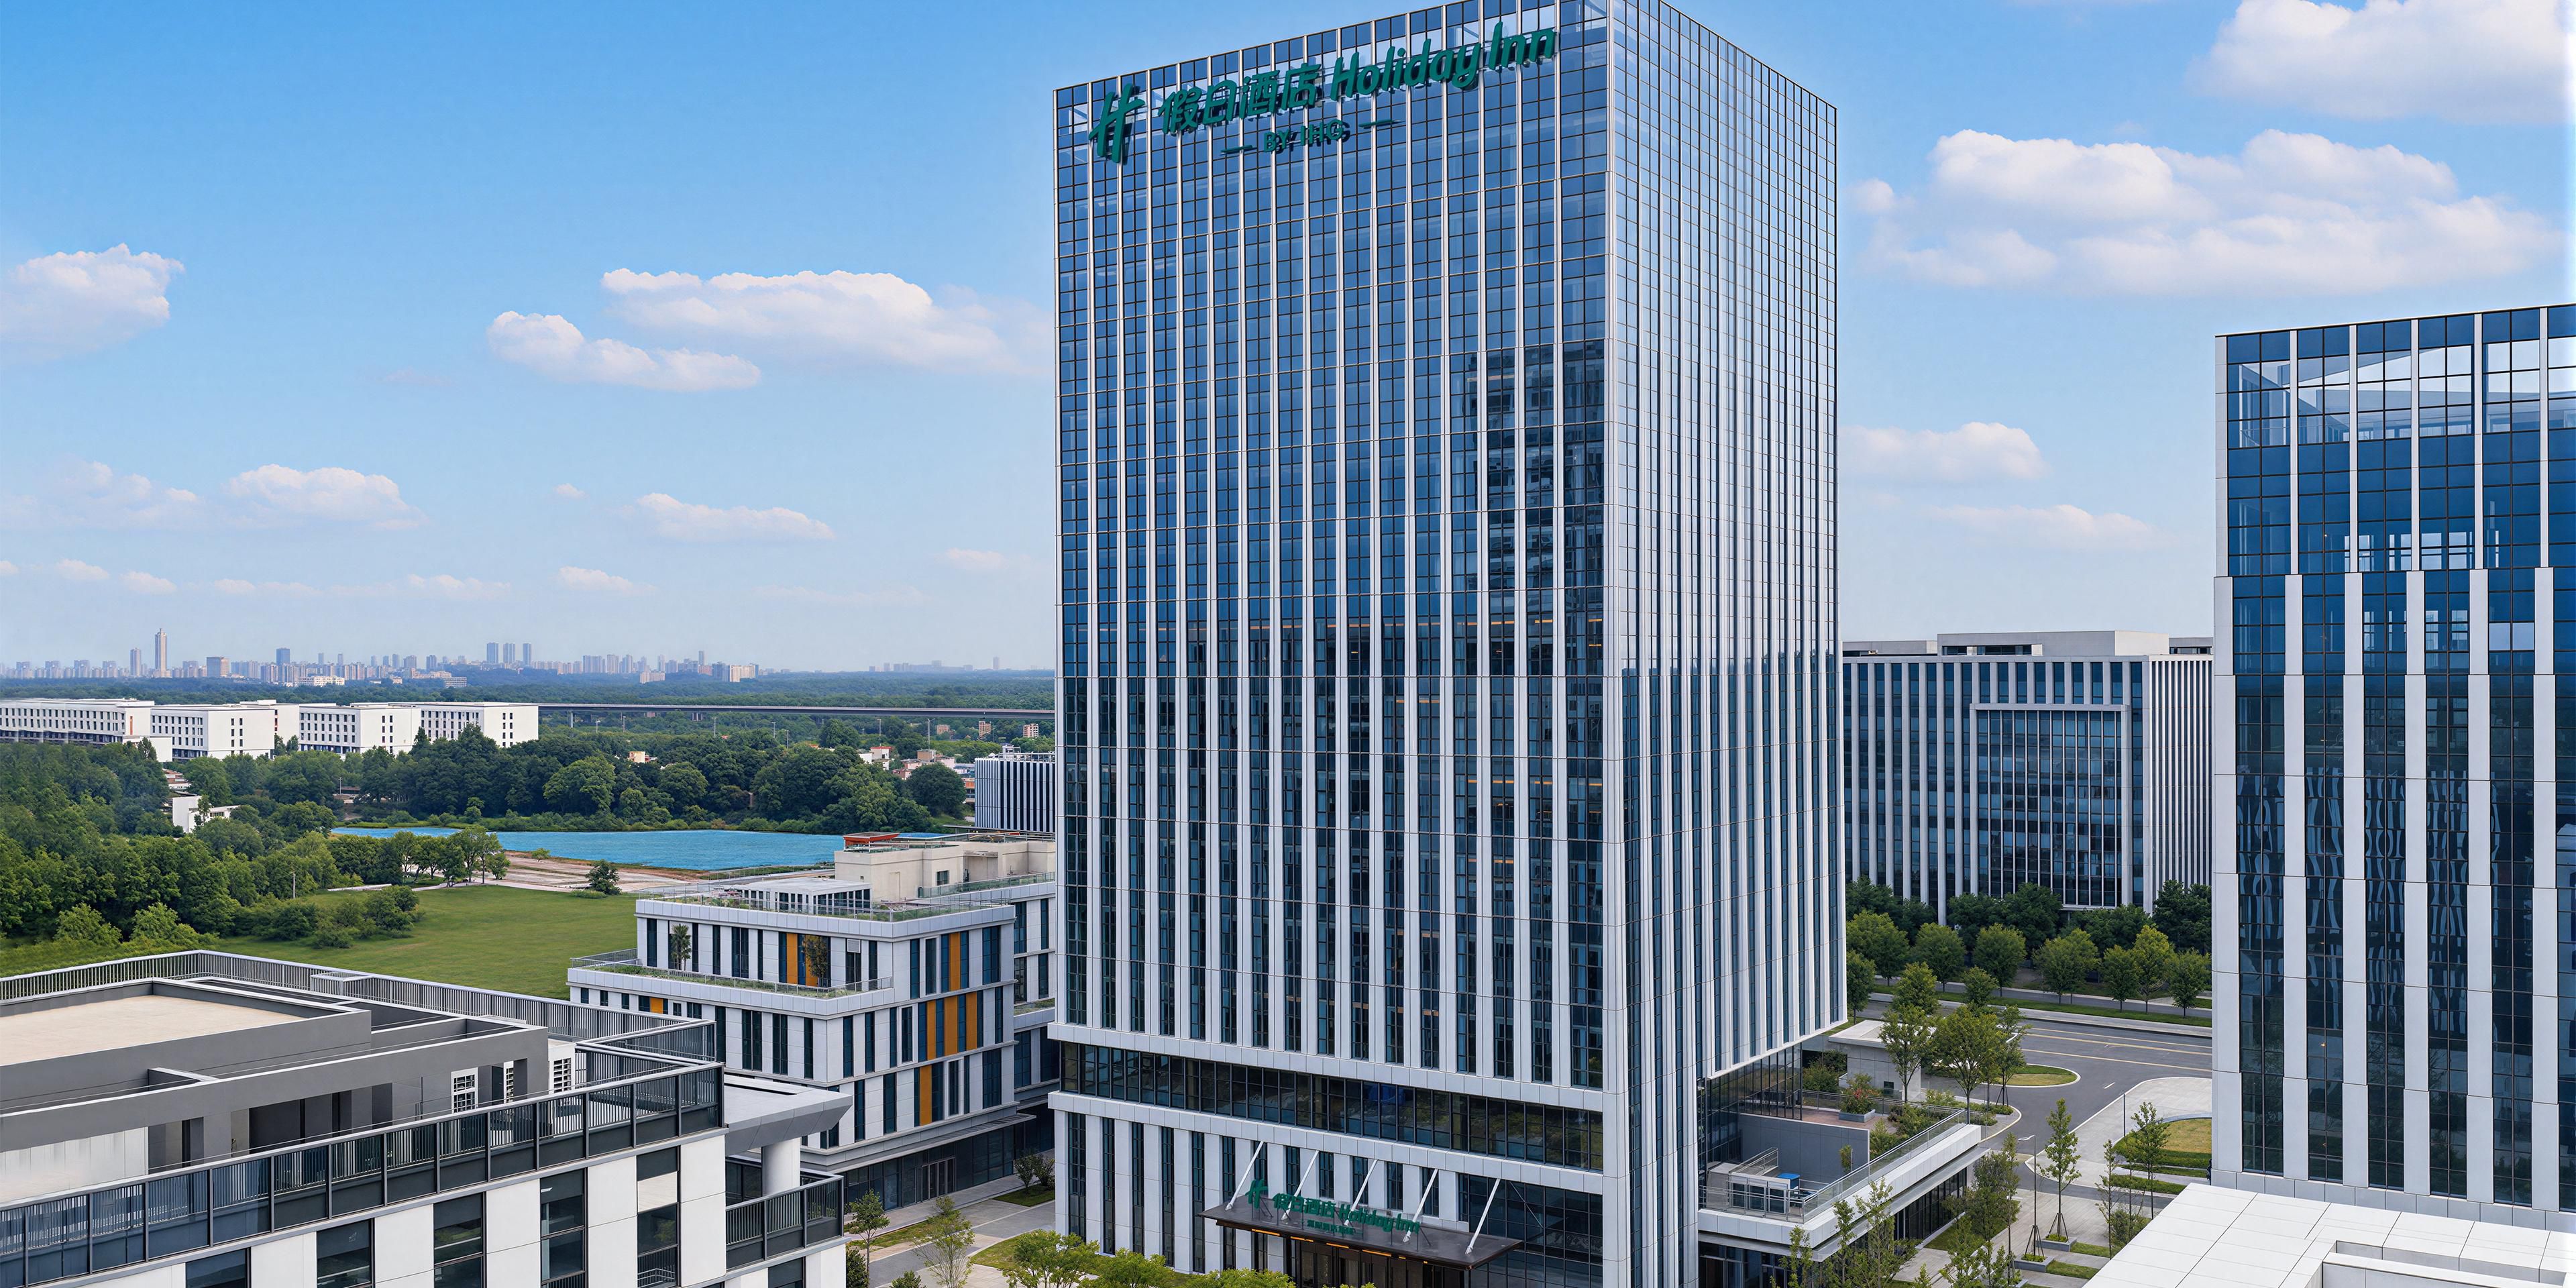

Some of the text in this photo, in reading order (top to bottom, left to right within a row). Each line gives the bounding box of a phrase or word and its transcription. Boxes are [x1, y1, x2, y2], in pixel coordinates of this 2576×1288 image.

[1157, 21, 1556, 134] 假日酒店 Holiday Inn
[1264, 119, 1345, 152] BY IHG
[1272, 1193, 1336, 1219] 假日酒店
[1338, 1203, 1395, 1232] Holiday
[1396, 1213, 1420, 1234] Inn
